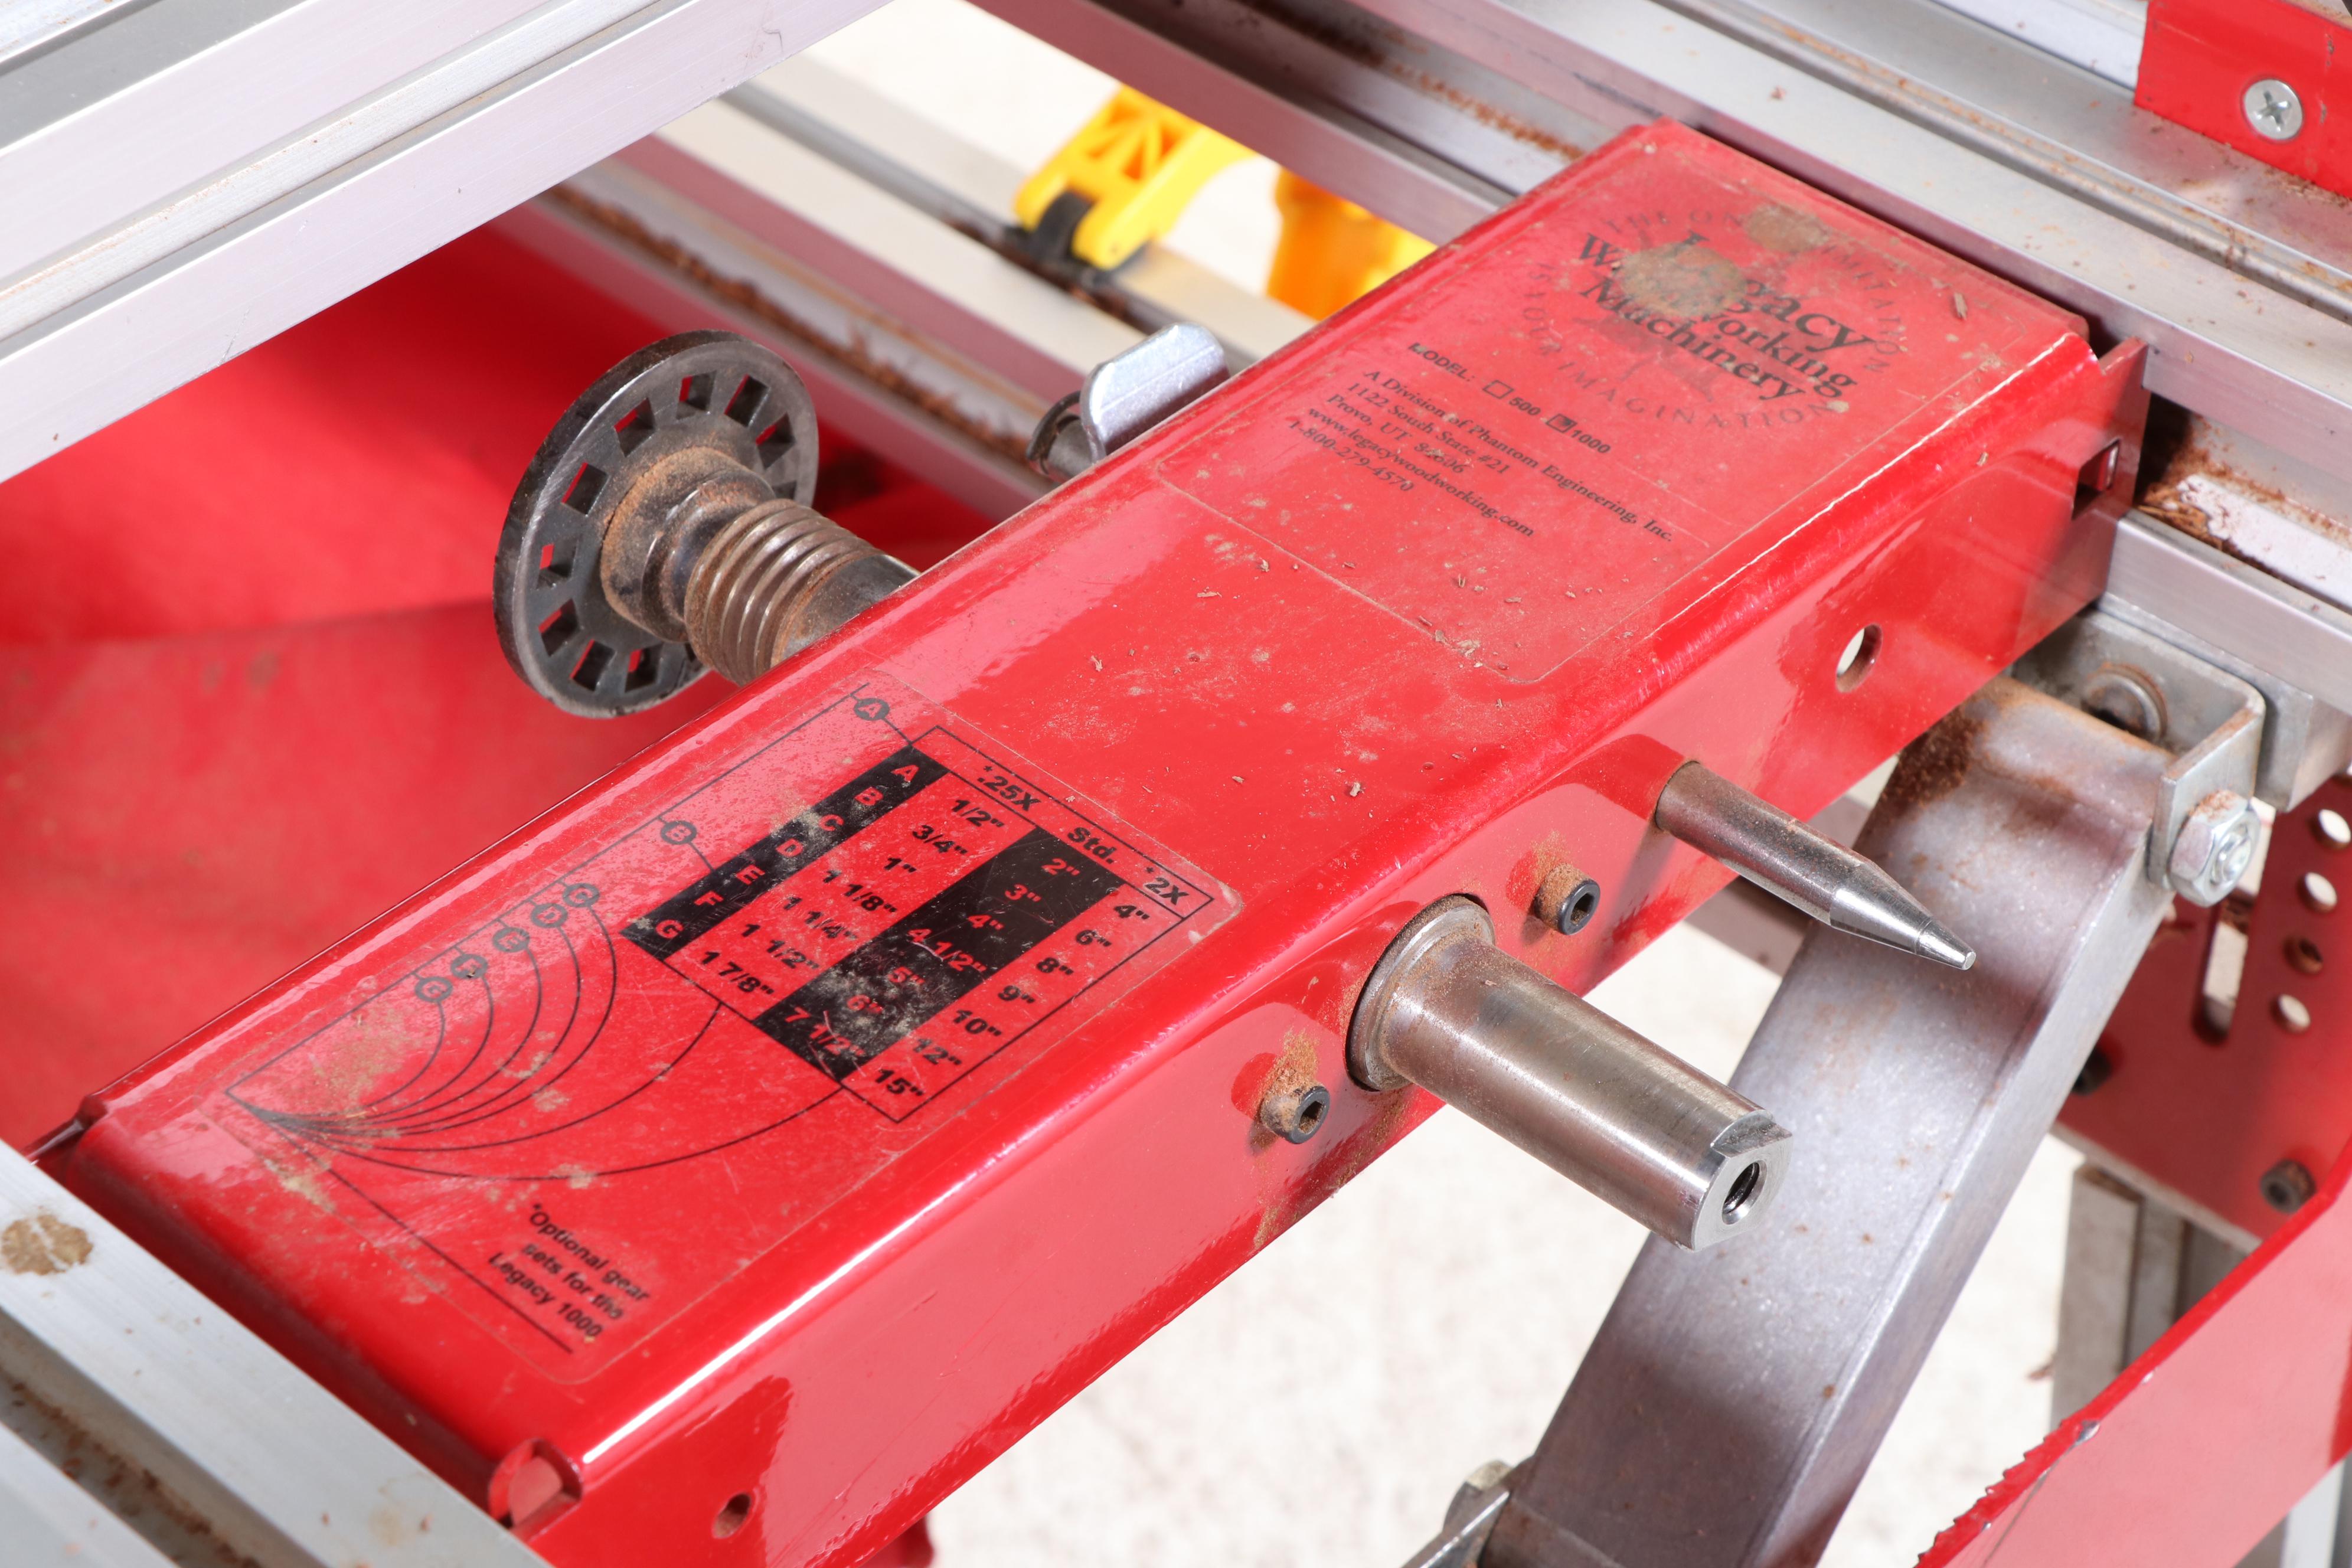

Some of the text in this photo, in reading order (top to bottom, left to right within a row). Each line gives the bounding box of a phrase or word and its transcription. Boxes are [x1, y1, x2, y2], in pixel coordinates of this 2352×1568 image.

[1578, 277, 1807, 400] Machinery
[1289, 420, 1414, 492] 1-800-279-4570
[1327, 393, 1373, 426] Provo,
[1380, 422, 1413, 442] UT
[1348, 383, 1511, 474] 1122 South State #21
[1364, 371, 1672, 542] A Division of Phantom Engineering, Inc.
[1408, 342, 1611, 454] MODEL: 500 1000
[1308, 407, 1534, 537] www.legacywoodworking.com
[858, 701, 887, 718] A
[665, 824, 692, 842] B
[854, 786, 1113, 949] B 3/4" 3" 6"
[890, 765, 1151, 921] A 1/2" 2" 4"
[1067, 826, 1116, 864] Std.
[736, 864, 766, 886] E
[783, 896, 803, 912] 1
[887, 966, 926, 986] 5"
[953, 1008, 1003, 1039] 10"
[776, 838, 804, 857] D
[823, 870, 843, 884] 1
[844, 884, 899, 914] 1/8"
[907, 927, 933, 944] 4
[998, 985, 1036, 1006] 9"
[819, 814, 1075, 976] C 1" 4" 8"
[655, 919, 684, 939] G
[700, 950, 721, 966] 1
[718, 962, 775, 996] 7/8"
[784, 1006, 811, 1024] 7
[874, 1068, 925, 1098] 15"
[695, 891, 963, 1067] F 1 1/2" 6" 12"
[488, 1252, 605, 1338] Legacy 1000
[522, 1243, 624, 1320] sets for the
[602, 1269, 651, 1302] gear
